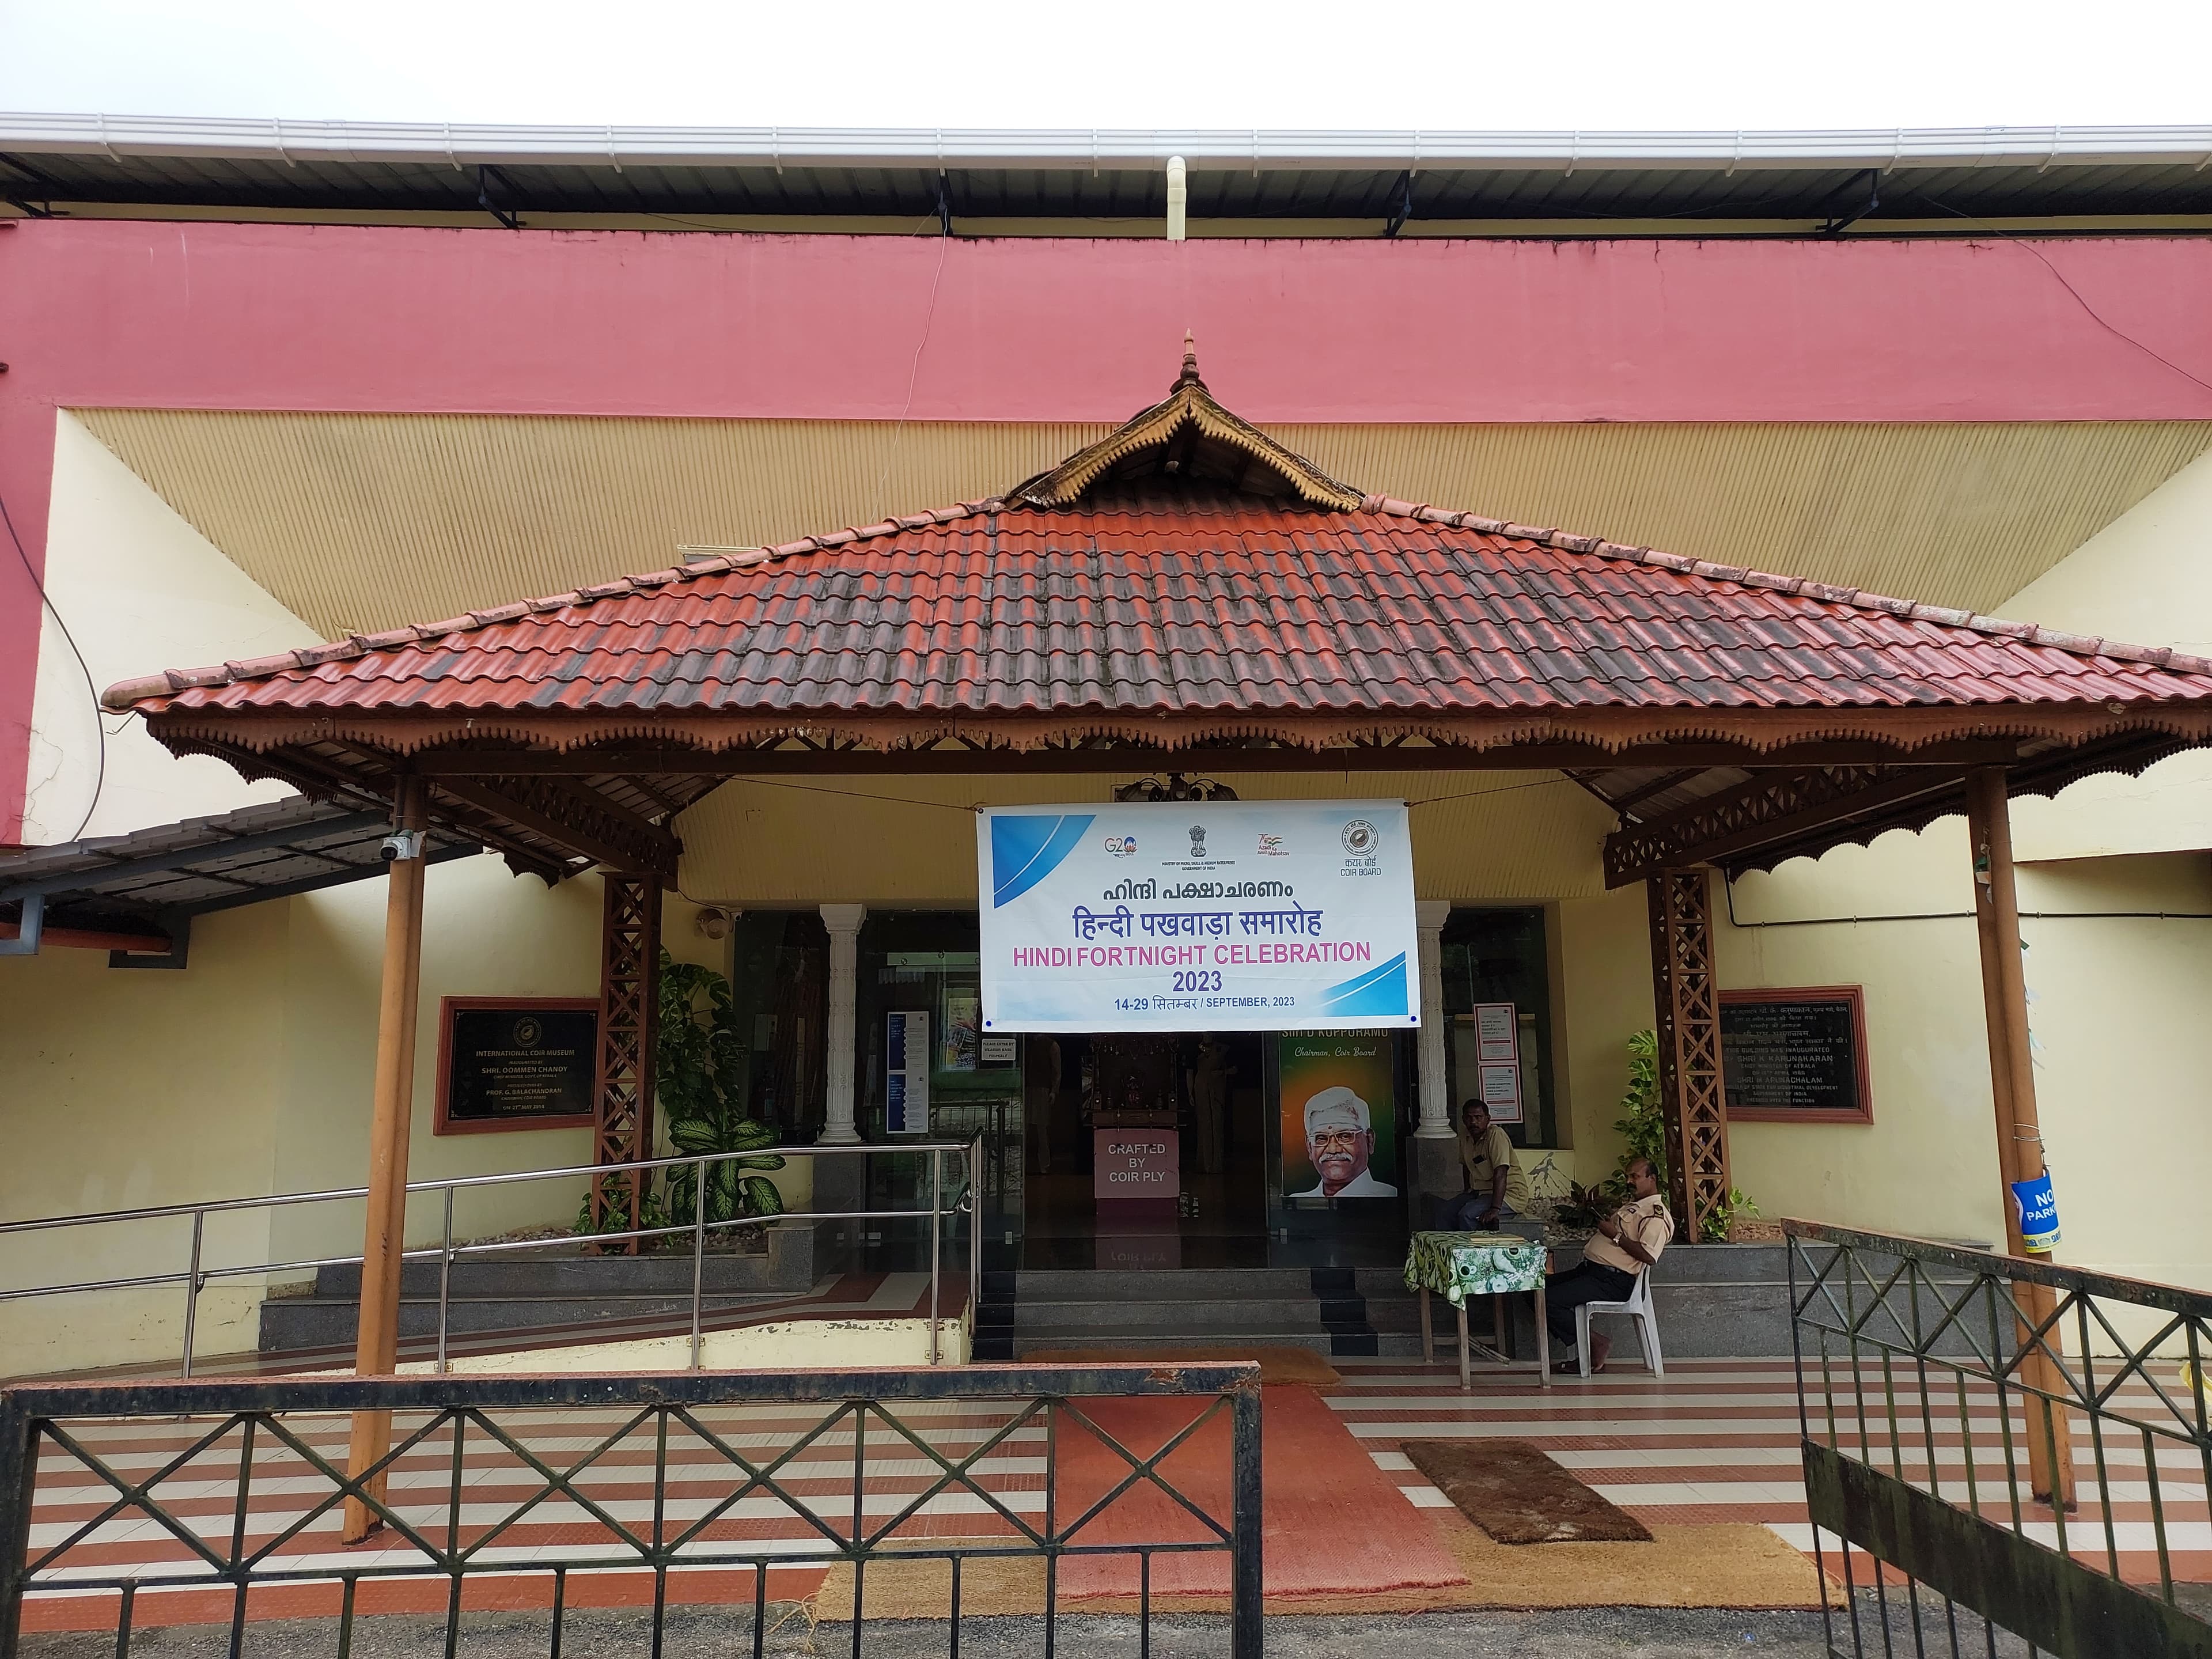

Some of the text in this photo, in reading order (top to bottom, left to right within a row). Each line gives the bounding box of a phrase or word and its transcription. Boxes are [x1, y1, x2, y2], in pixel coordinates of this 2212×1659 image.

[1340, 868, 1381, 876] COIR BOARD
[1104, 878, 1157, 900] ഹിന്ദി
[1072, 900, 1324, 940] हिन्दी पखवाड़ा समारोह
[1013, 941, 1371, 967] HINDI FORTNIGHT CELEBRATION
[1172, 971, 1222, 992] 2023
[1115, 998, 1149, 1011] 14-29
[1152, 995, 1198, 1011] सितम्बर
[1206, 996, 1270, 1008] SEPTEMBER,
[1272, 996, 1295, 1007] 2023
[1294, 1046, 1377, 1057] Chairman, Coir Board
[1108, 1143, 1166, 1154] CRAFTED
[1129, 1158, 1146, 1168] BY
[1109, 1172, 1165, 1182] COIR PLY
[2035, 1189, 2054, 1207] NO
[2026, 1206, 2056, 1221] PARK
